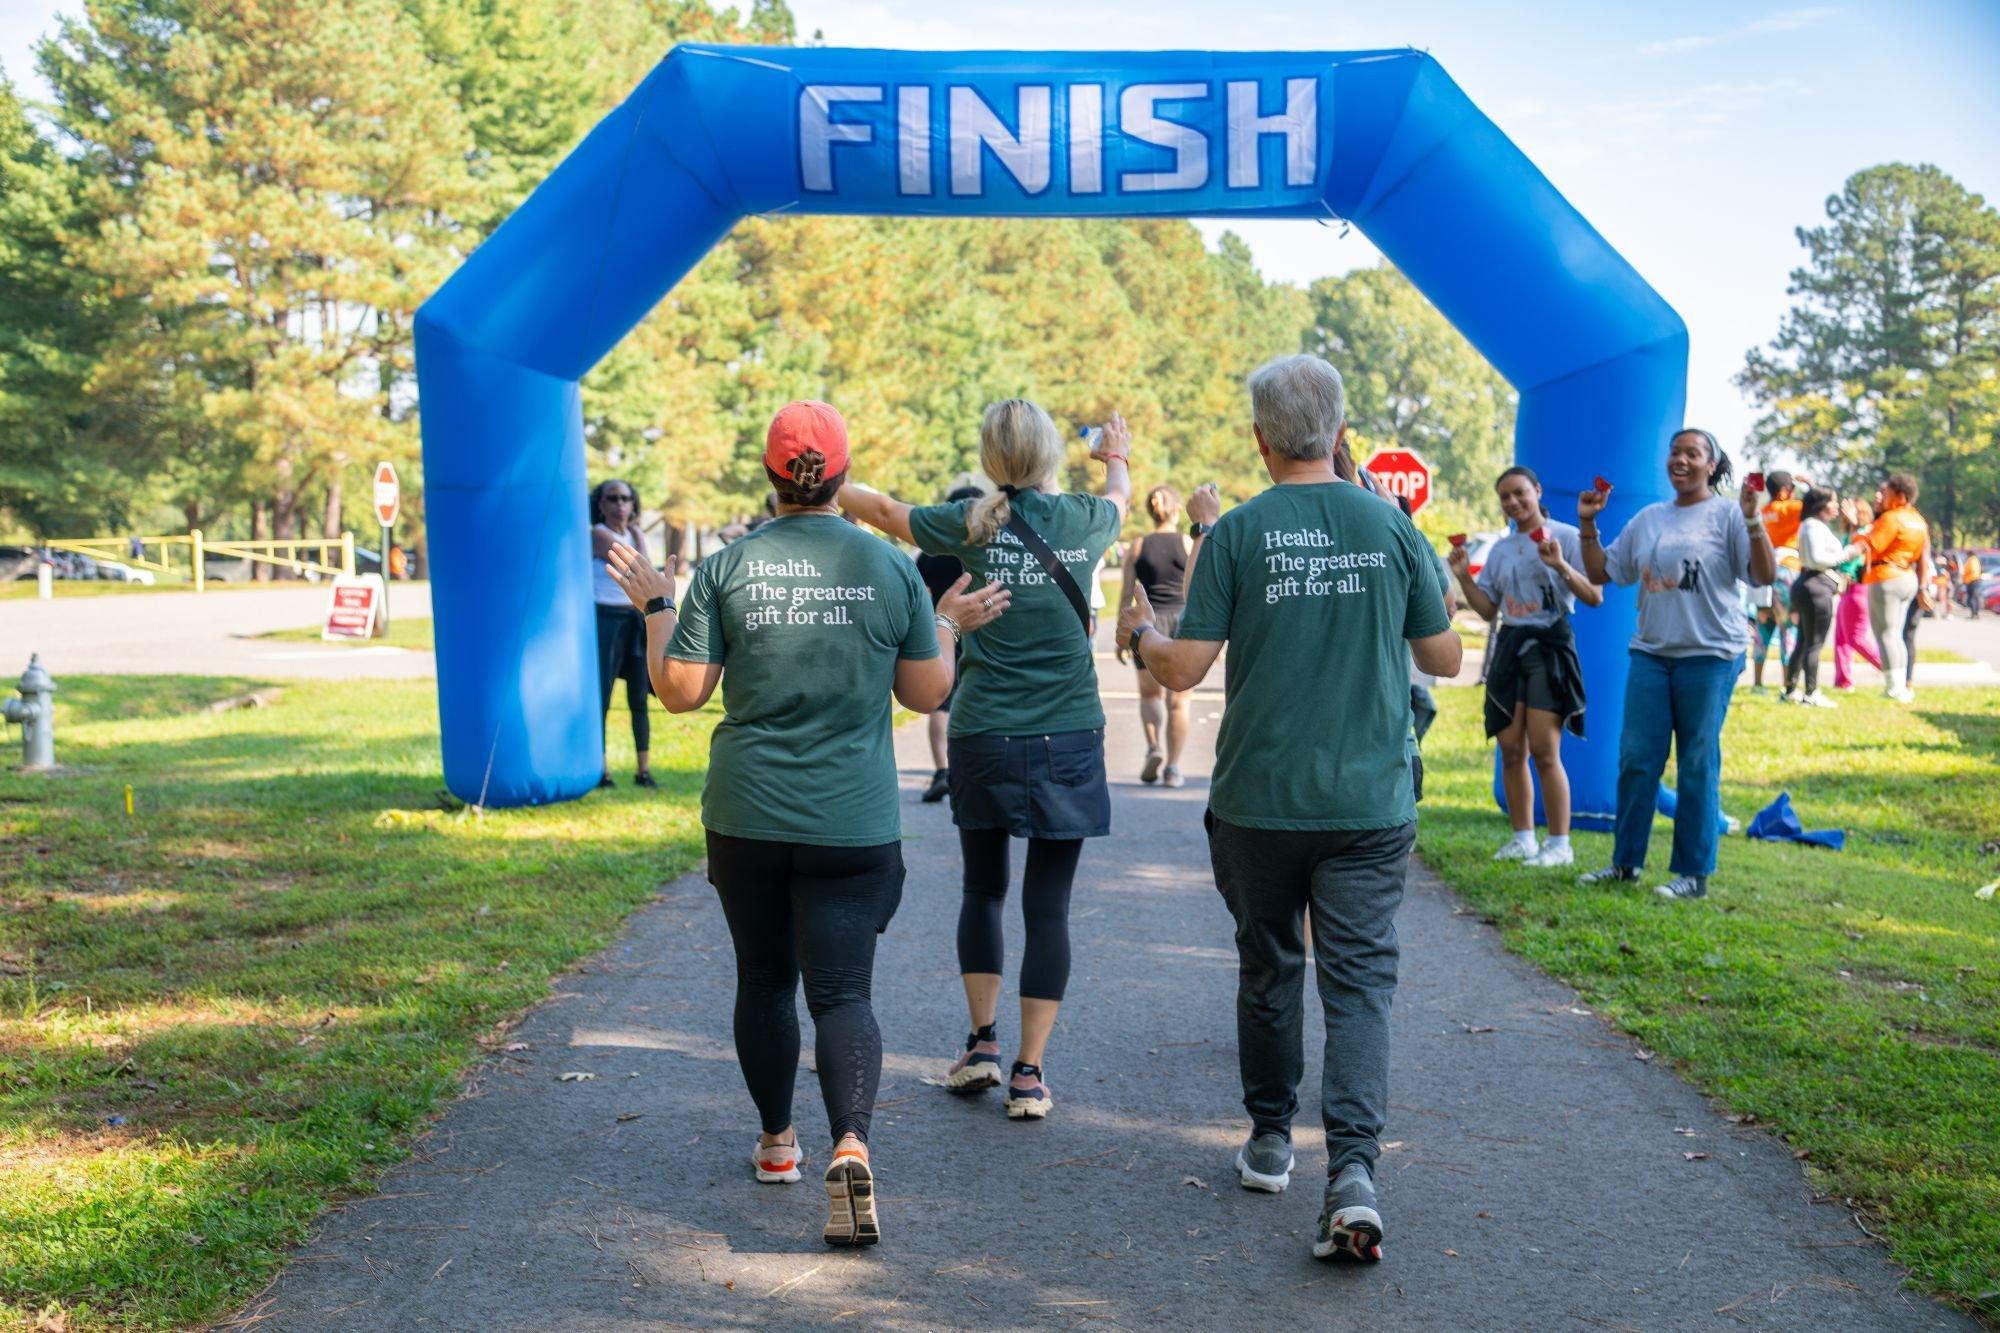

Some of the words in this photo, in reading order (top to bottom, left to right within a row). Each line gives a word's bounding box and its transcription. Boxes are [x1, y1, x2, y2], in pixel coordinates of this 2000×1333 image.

[798, 76, 1318, 196] FINISH
[1372, 470, 1426, 500] TOP
[1264, 528, 1335, 549] Health.
[746, 558, 821, 577] Health.
[986, 548, 1019, 564] The
[1265, 552, 1305, 573] The
[1308, 551, 1387, 577] greatest
[1018, 568, 1047, 585] for
[1265, 576, 1300, 604] gift
[1304, 576, 1333, 595] for
[1336, 573, 1367, 594] all.
[746, 582, 787, 600] The
[792, 585, 875, 606] greatest
[745, 605, 782, 631] gift
[787, 605, 818, 624] for
[822, 606, 853, 624] all.
